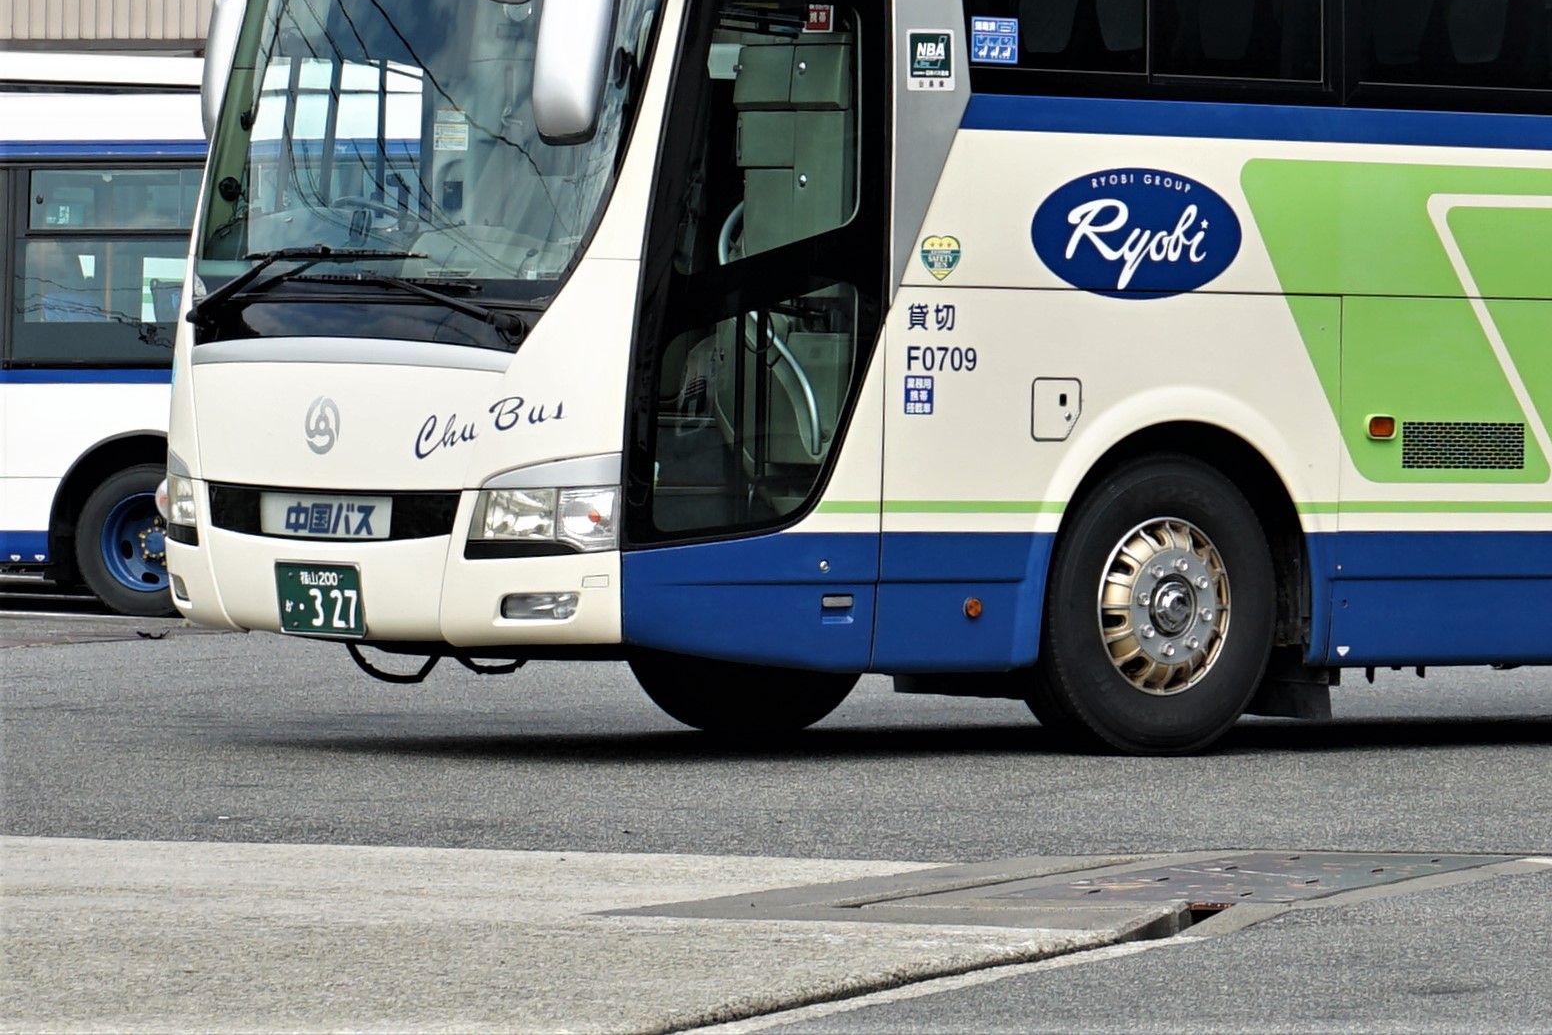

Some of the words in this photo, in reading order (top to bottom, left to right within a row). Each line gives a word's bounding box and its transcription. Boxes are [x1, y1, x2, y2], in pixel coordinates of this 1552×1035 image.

[917, 43, 945, 57] NBA
[1091, 174, 1134, 189] RYOBI
[1143, 174, 1192, 193] GROUP
[1065, 198, 1208, 290] Ryobi
[907, 303, 955, 331] 貸切
[907, 345, 977, 371] F0709
[414, 414, 479, 460] Chu
[488, 396, 568, 431] Bus
[285, 501, 376, 536] 中国バス
